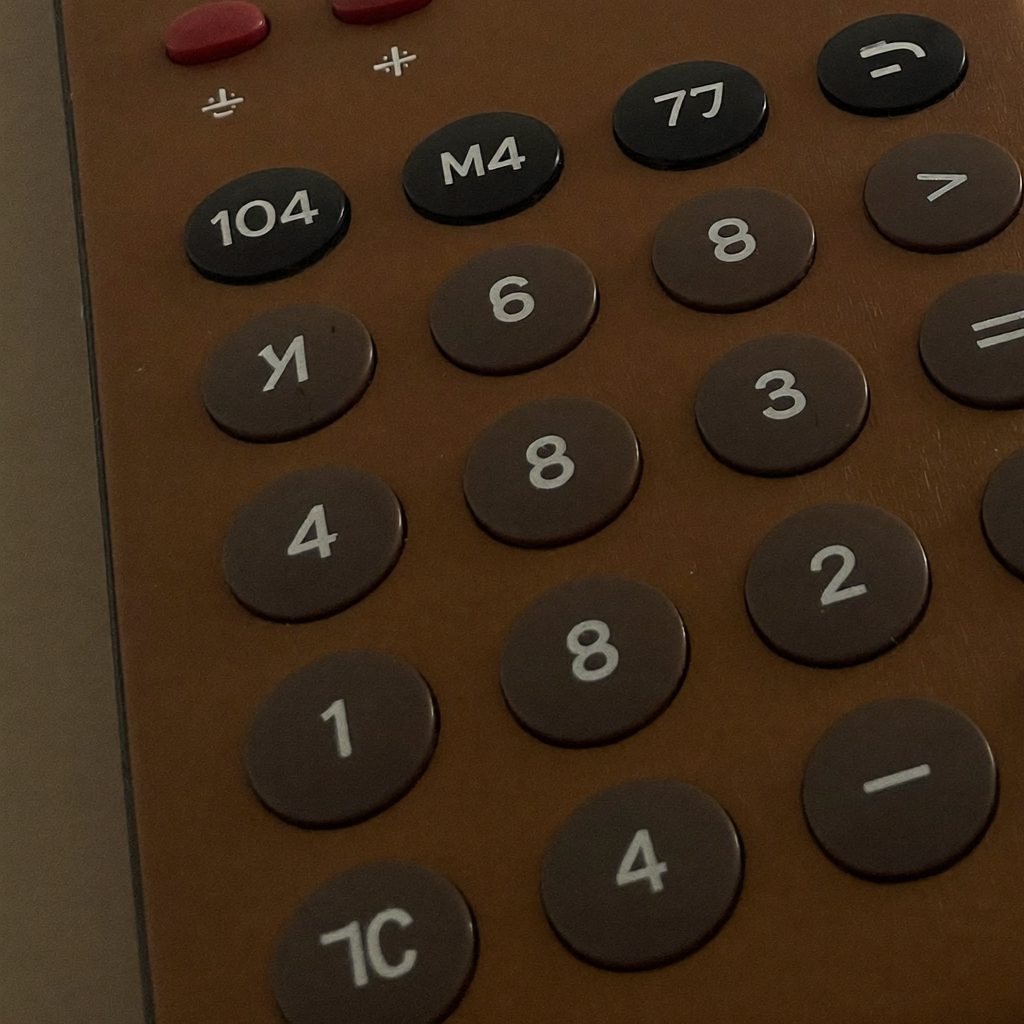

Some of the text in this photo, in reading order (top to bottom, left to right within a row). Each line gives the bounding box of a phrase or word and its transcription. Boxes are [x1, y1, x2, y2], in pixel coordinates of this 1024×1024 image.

[440, 136, 526, 185] M4
[210, 189, 319, 247] 104
[707, 217, 756, 263] 8
[489, 275, 535, 323] 6
[754, 369, 807, 420] 3
[525, 435, 575, 490] 8
[287, 504, 338, 559] 4
[810, 544, 867, 606] 2
[566, 619, 619, 682] 8
[320, 699, 353, 758] 1
[616, 829, 668, 892] 4
